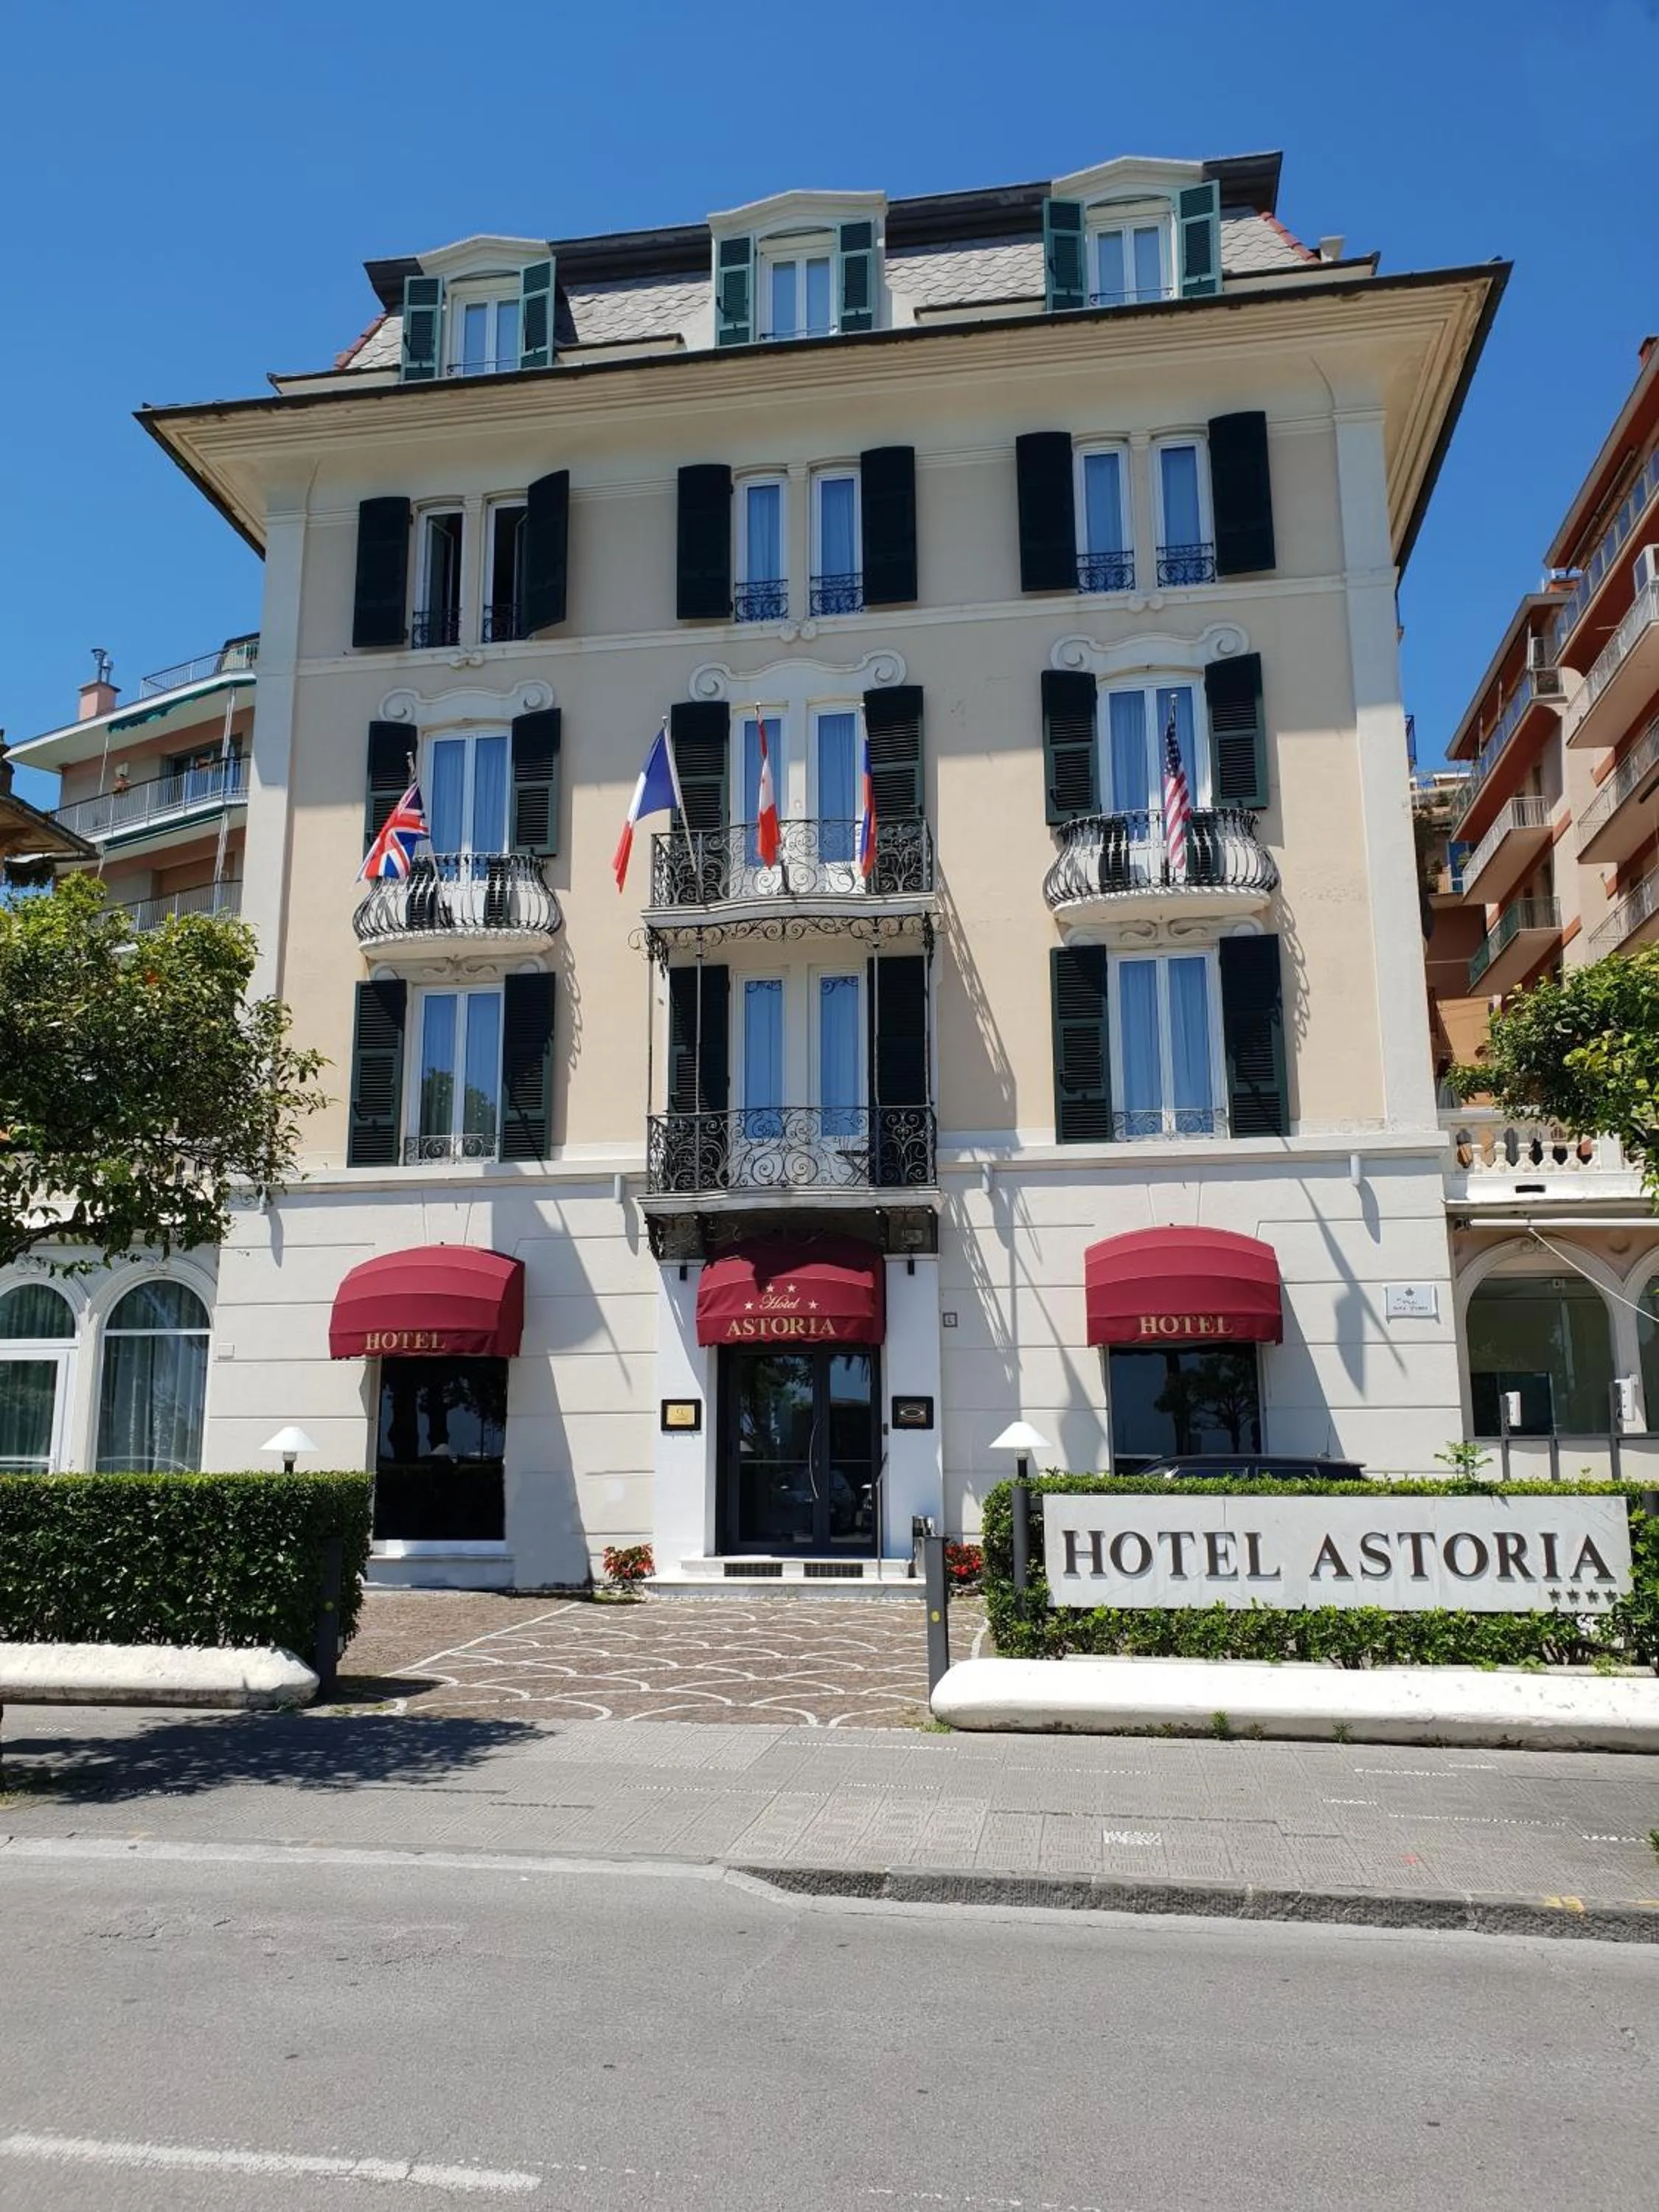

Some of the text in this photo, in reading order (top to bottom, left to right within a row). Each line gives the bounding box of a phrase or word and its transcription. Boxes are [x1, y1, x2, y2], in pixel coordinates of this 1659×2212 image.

[759, 1294, 801, 1310] Hotel
[726, 1317, 836, 1336] ASTORIA
[1139, 1315, 1234, 1334] HOTEL
[366, 1332, 446, 1349] HOTEL
[1062, 1530, 1615, 1581] HOTEL ASTORIA
